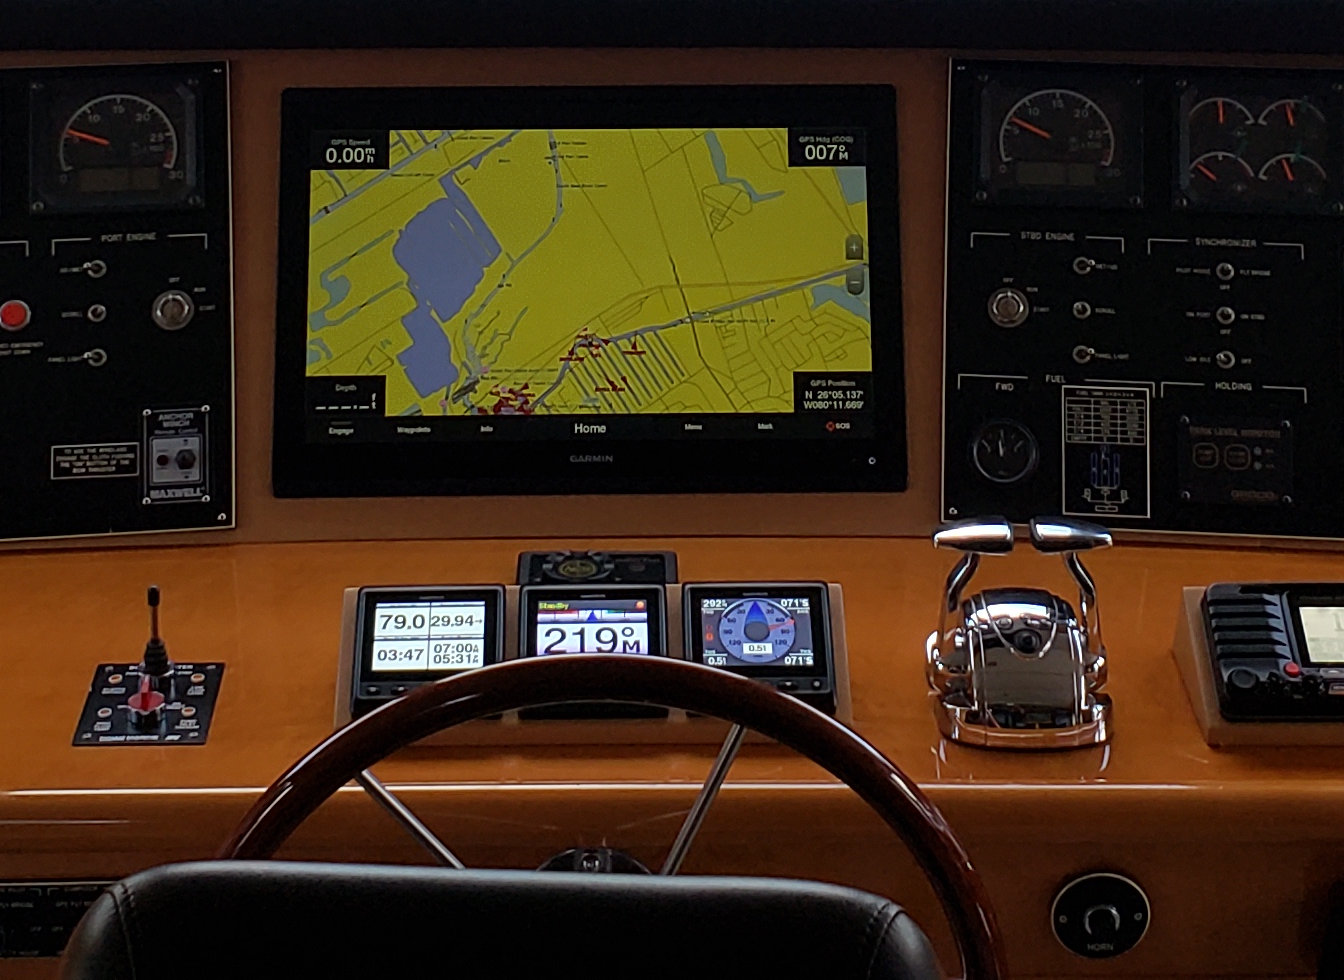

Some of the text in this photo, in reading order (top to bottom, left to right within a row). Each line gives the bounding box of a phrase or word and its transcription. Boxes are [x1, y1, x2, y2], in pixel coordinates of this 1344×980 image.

[325, 147, 365, 163] 0.00
[100, 231, 158, 243] PORT ENGINE
[1045, 374, 1066, 384] FUEL
[995, 382, 1014, 392] FWD
[1214, 381, 1253, 391] HOLDING
[574, 422, 607, 434] Home
[569, 454, 614, 463] GARMIN
[379, 613, 426, 630] 79.0
[430, 614, 474, 628] 29.94
[377, 648, 425, 662] 03:47
[1086, 942, 1114, 952] HORN
